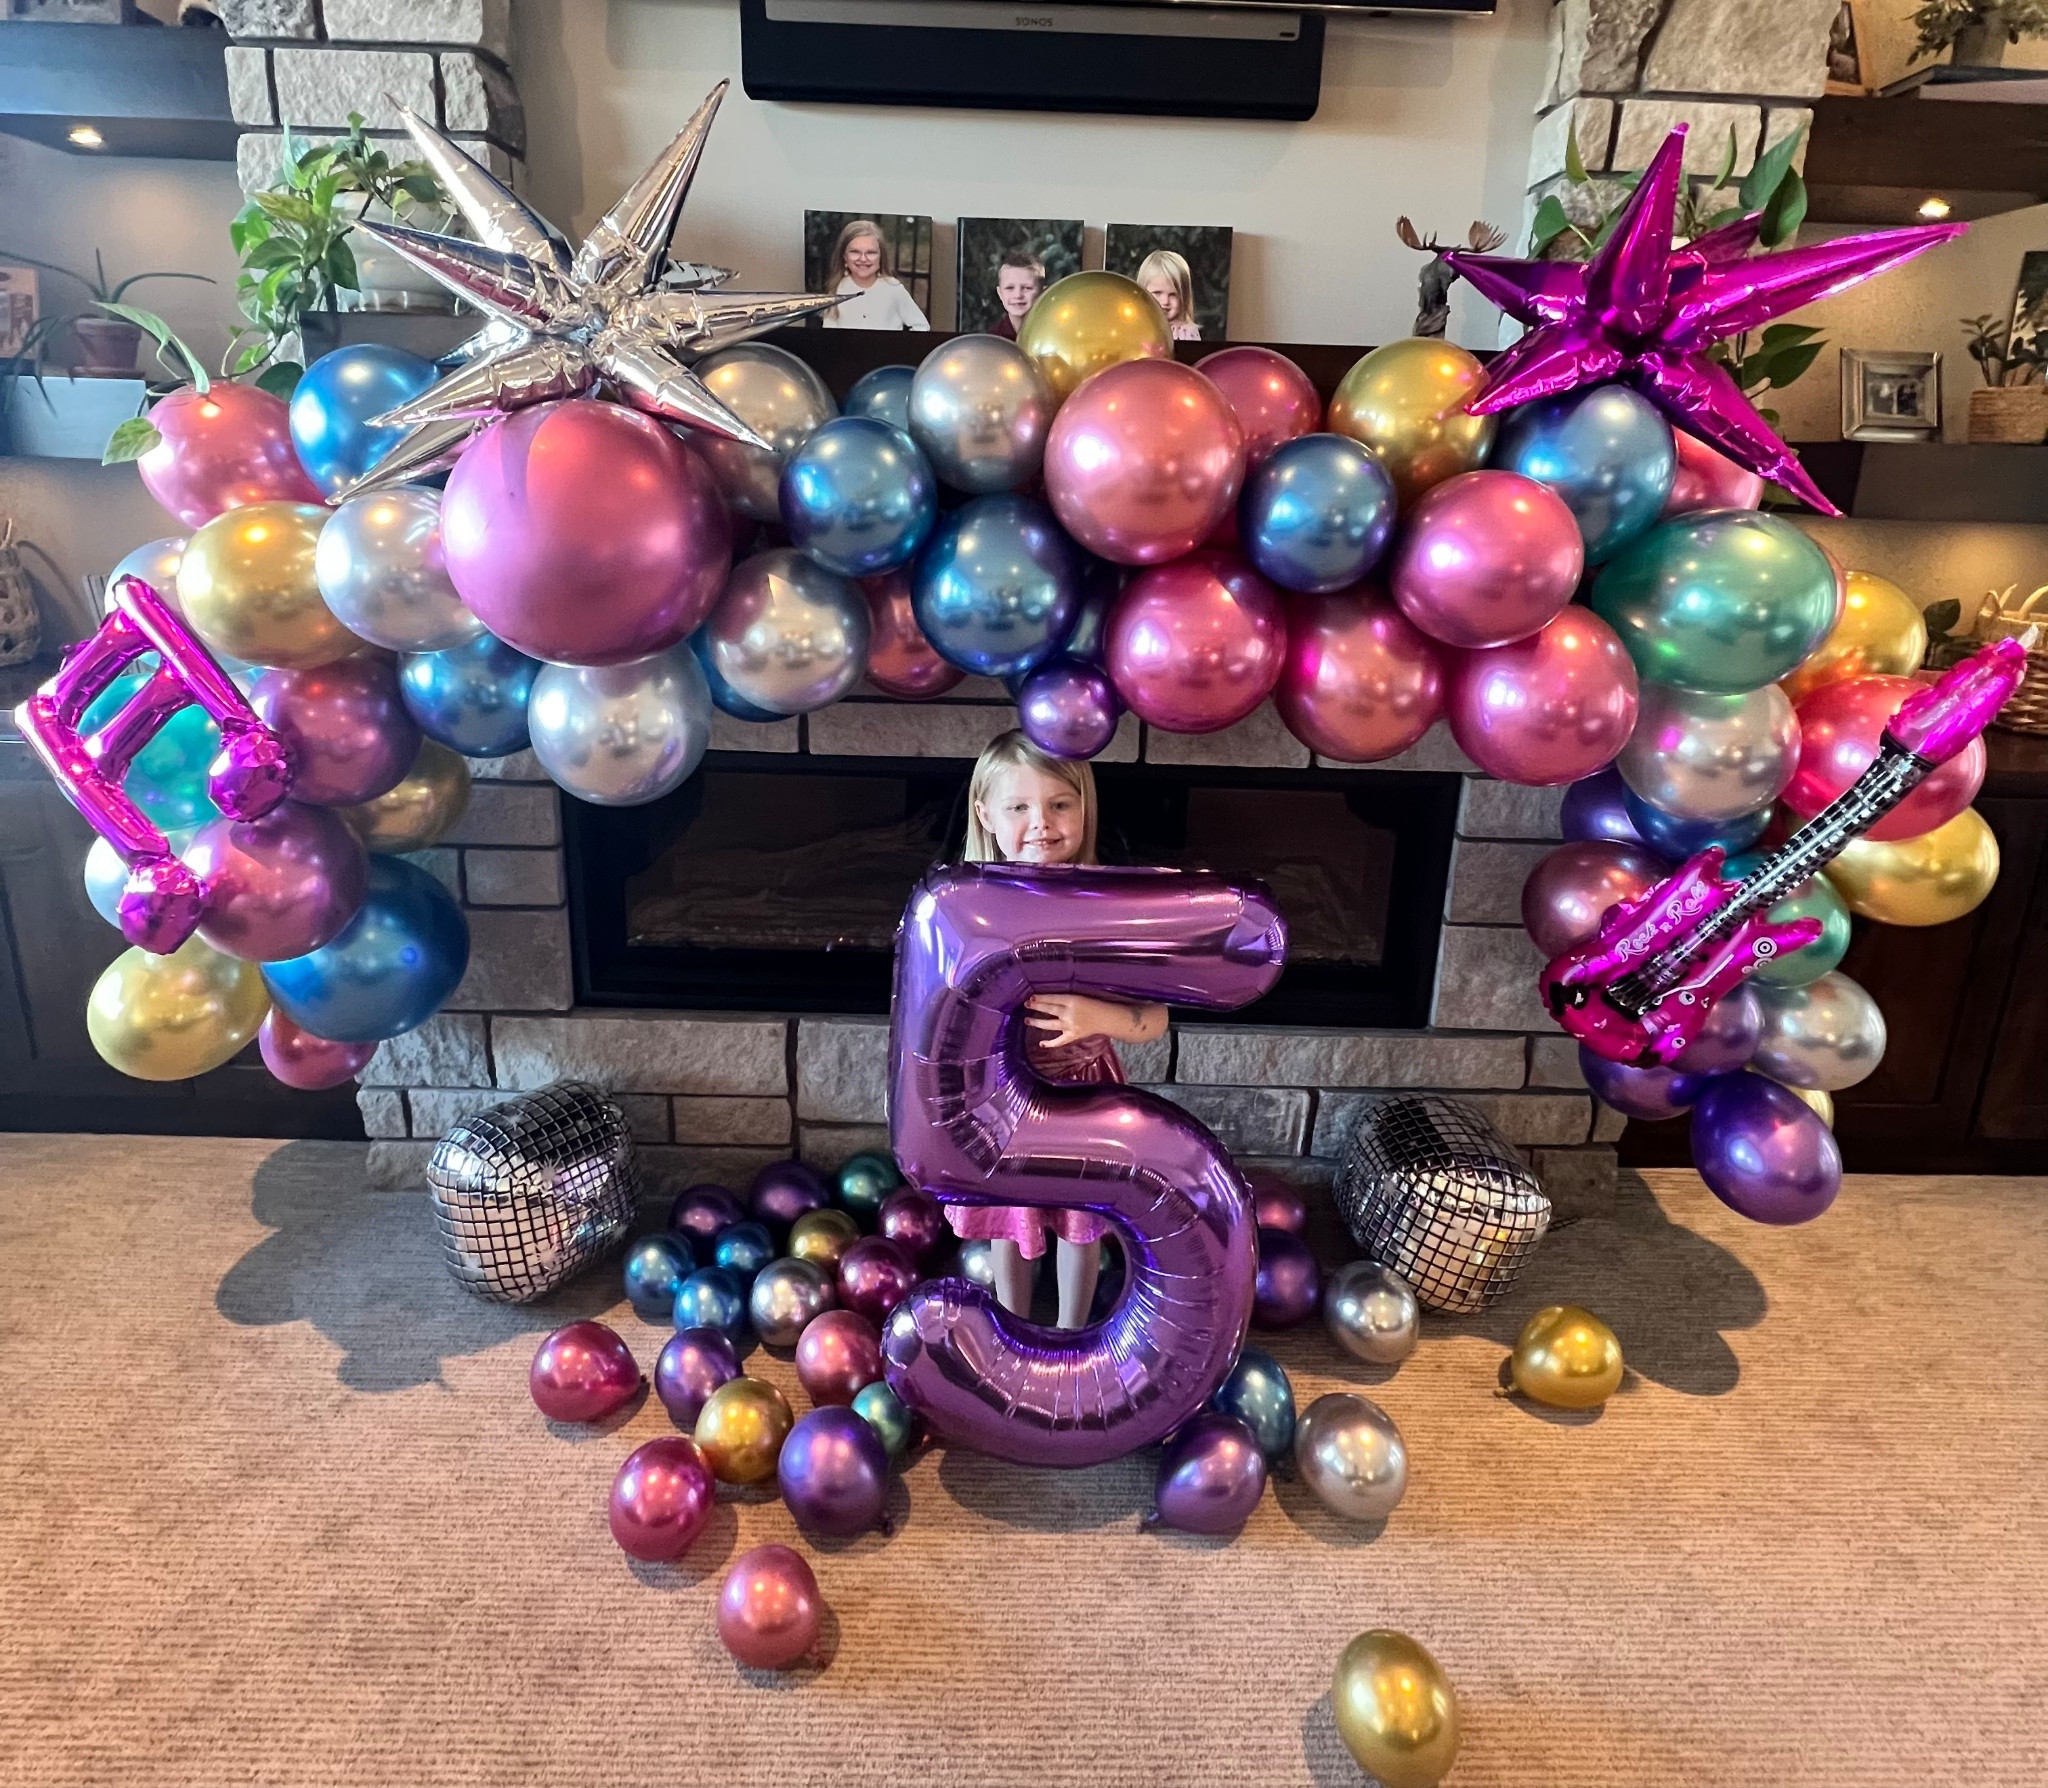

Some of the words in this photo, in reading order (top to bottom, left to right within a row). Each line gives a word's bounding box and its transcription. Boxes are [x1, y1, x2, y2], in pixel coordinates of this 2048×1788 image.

[1015, 16, 1053, 27] SONOS
[1614, 920, 1659, 963] Rock
[1666, 880, 1711, 925] Roll
[882, 862, 1288, 1467] 5
